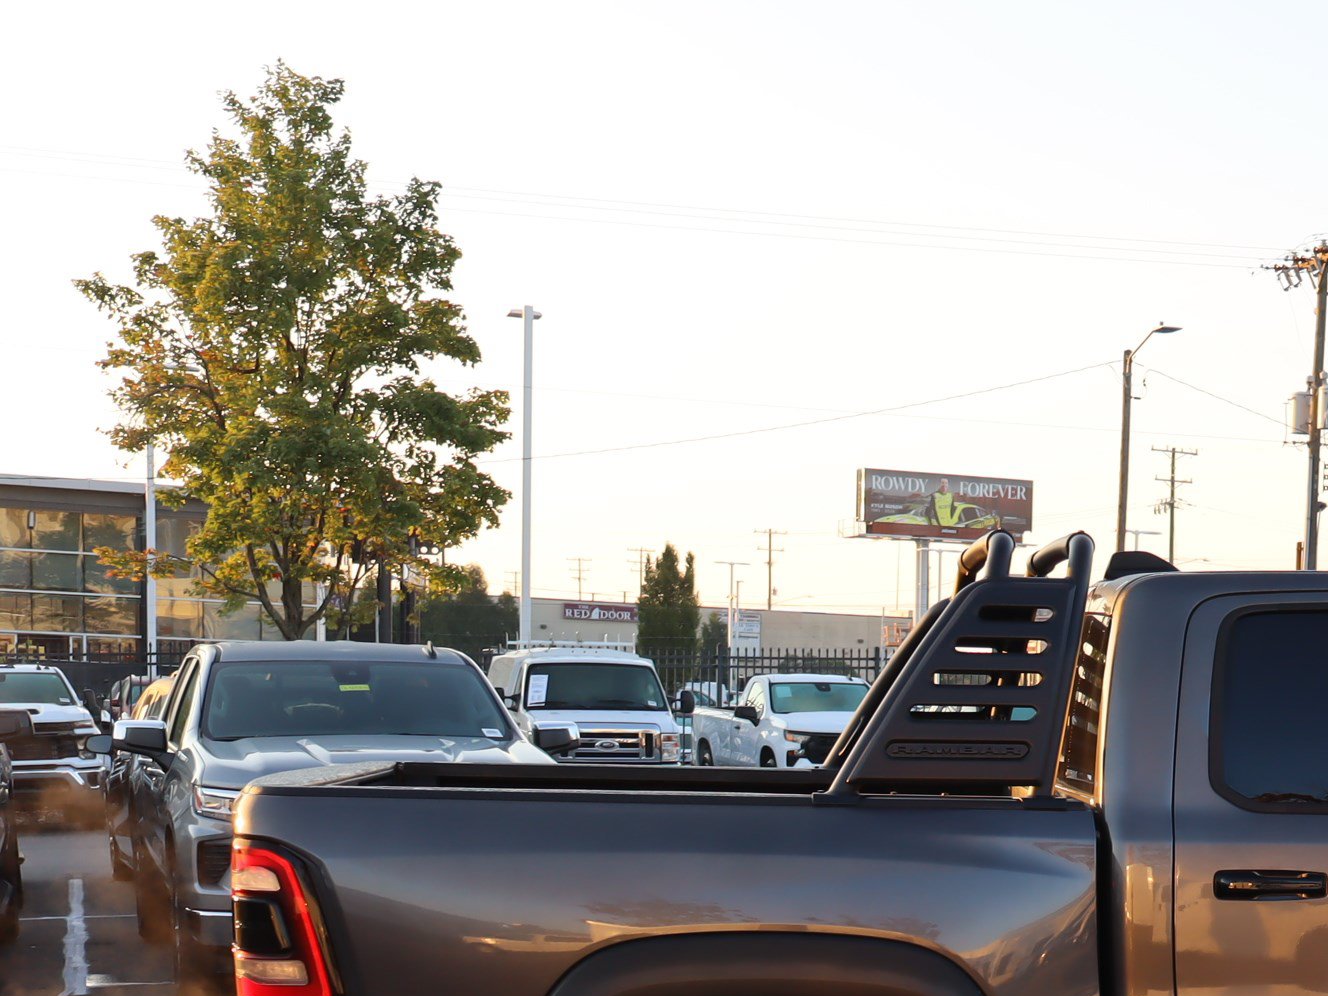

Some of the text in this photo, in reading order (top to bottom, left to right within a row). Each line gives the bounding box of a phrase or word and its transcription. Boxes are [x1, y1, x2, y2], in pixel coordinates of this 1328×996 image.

[871, 474, 1027, 500] ROWDY FOREVER
[565, 608, 631, 620] RED DOOR
